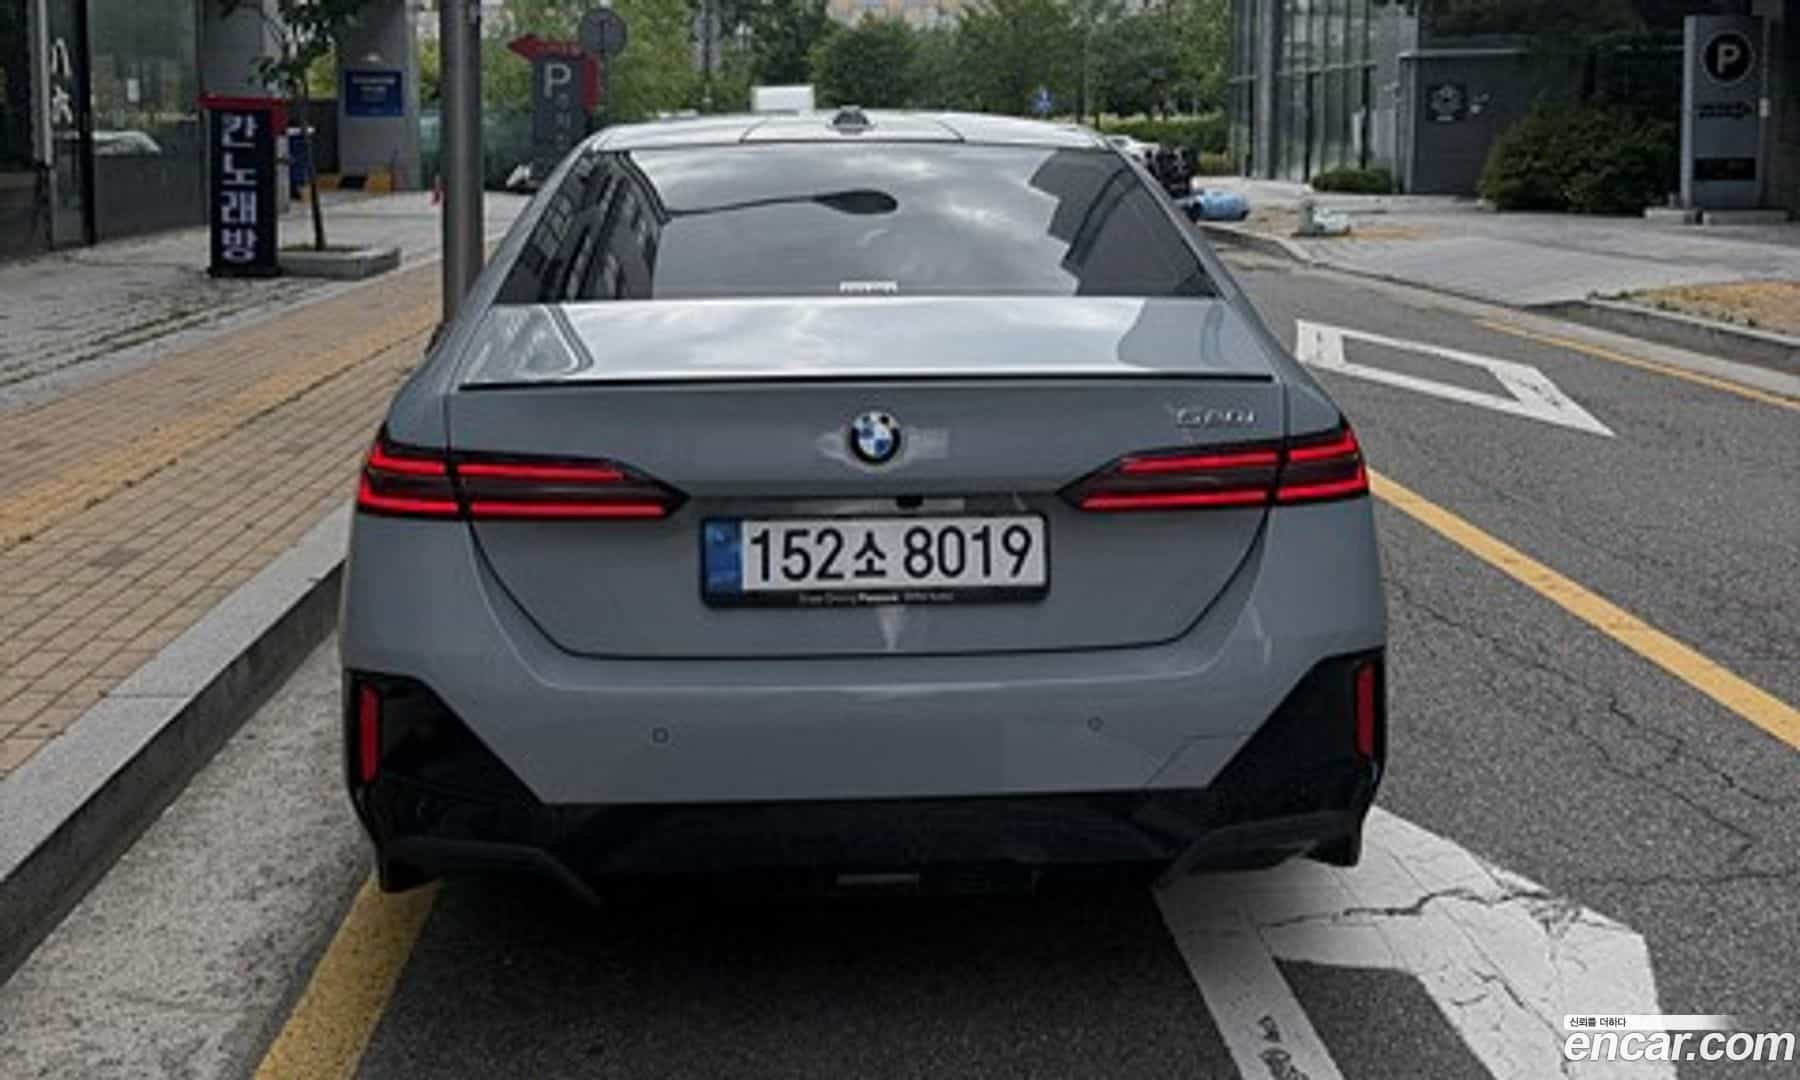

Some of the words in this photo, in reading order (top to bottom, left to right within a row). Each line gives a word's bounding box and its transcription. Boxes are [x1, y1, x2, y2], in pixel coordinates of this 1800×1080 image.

[1716, 43, 1742, 74] P
[543, 63, 571, 98] P
[751, 528, 887, 581] 152소
[903, 525, 1033, 578] 8019
